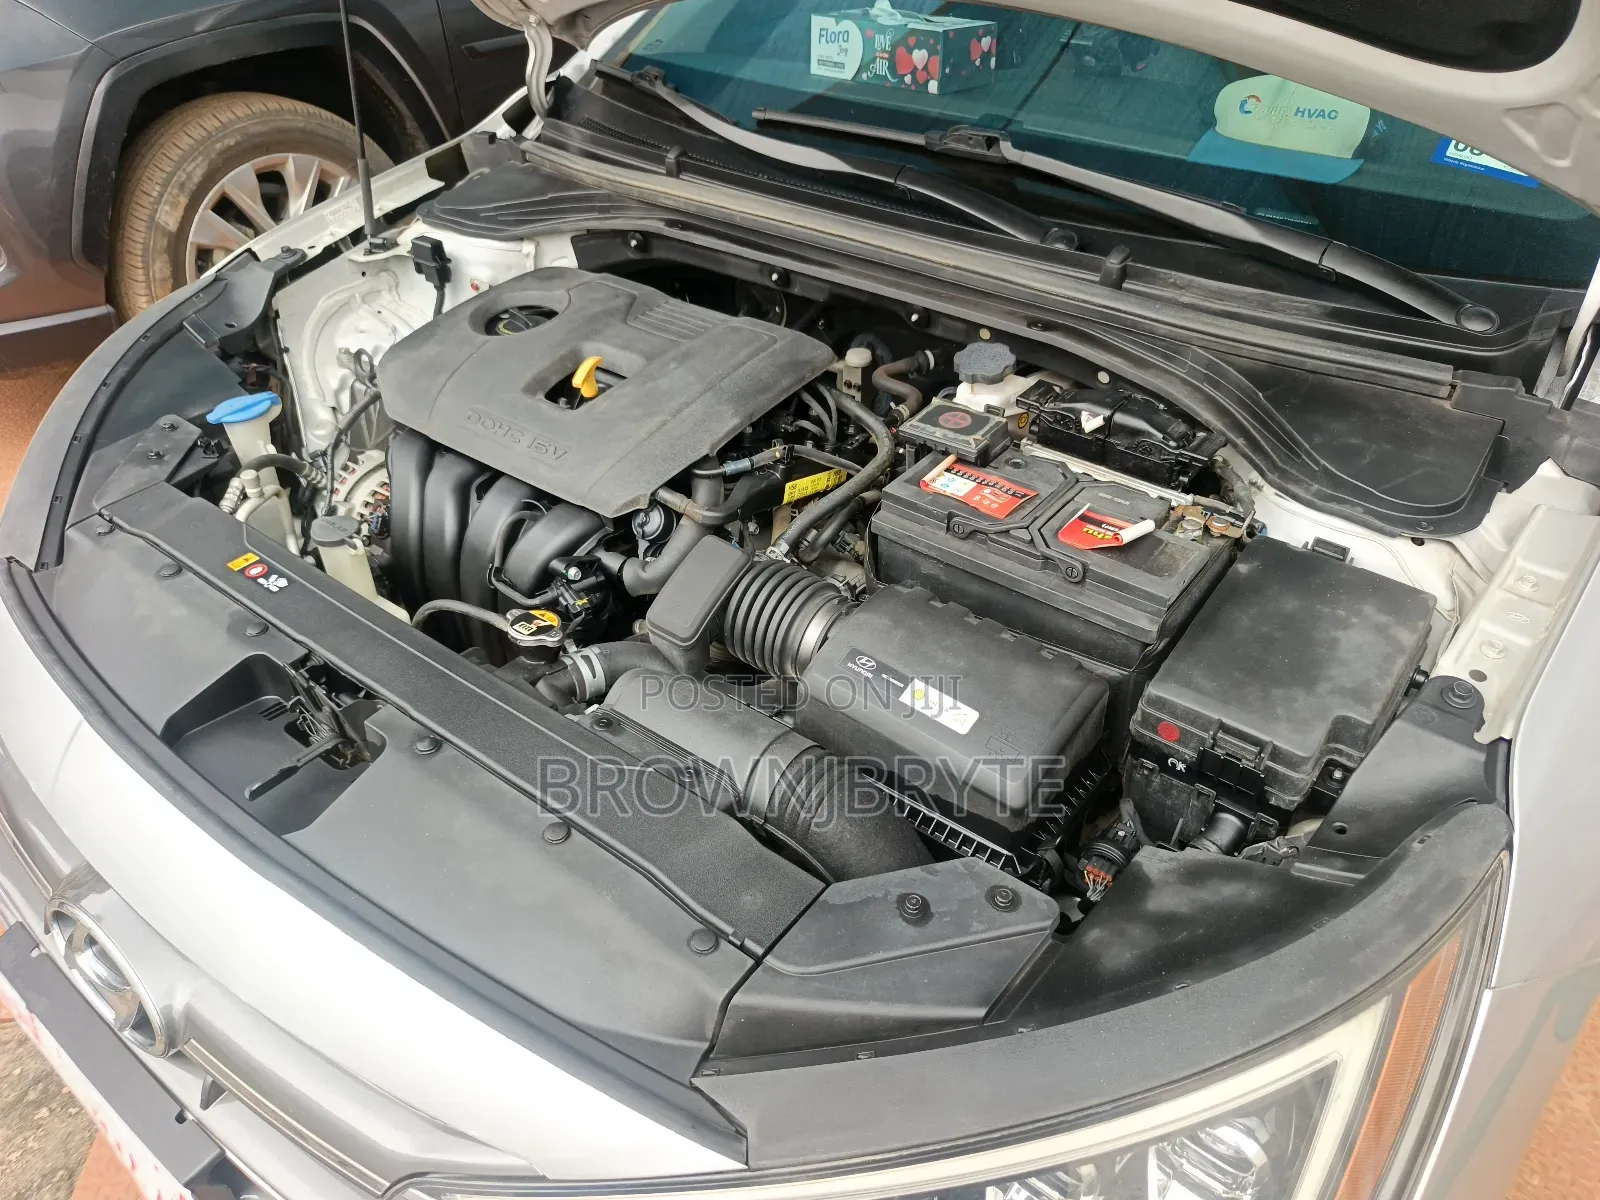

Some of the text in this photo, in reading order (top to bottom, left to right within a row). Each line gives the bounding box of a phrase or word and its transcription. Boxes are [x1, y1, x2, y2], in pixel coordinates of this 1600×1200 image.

[818, 28, 849, 44] Flora
[868, 57, 898, 82] AIR
[1294, 106, 1340, 121] HVAC
[847, 662, 873, 678] HYUNDAI
